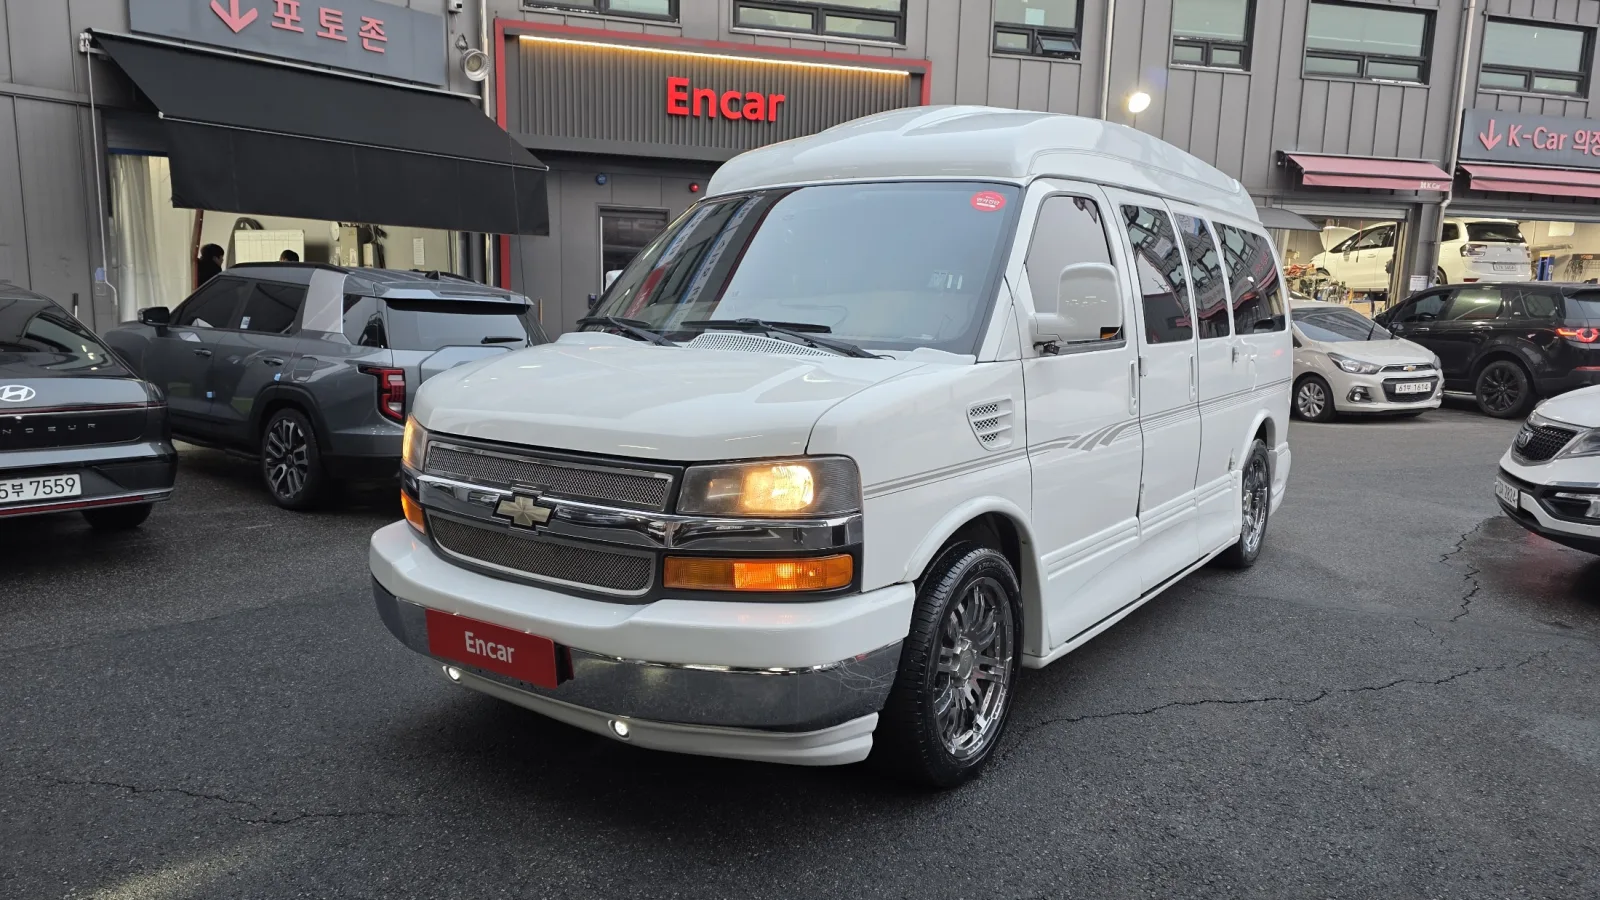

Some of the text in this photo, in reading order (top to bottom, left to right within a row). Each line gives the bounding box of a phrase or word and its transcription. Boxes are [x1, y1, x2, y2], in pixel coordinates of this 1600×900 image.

[271, 0, 388, 53] 포토존
[667, 76, 786, 122] Encar
[1508, 124, 1568, 150] K-Car
[1414, 383, 1429, 391] 1614
[29, 477, 76, 497] 7559
[464, 631, 515, 663] Encar
